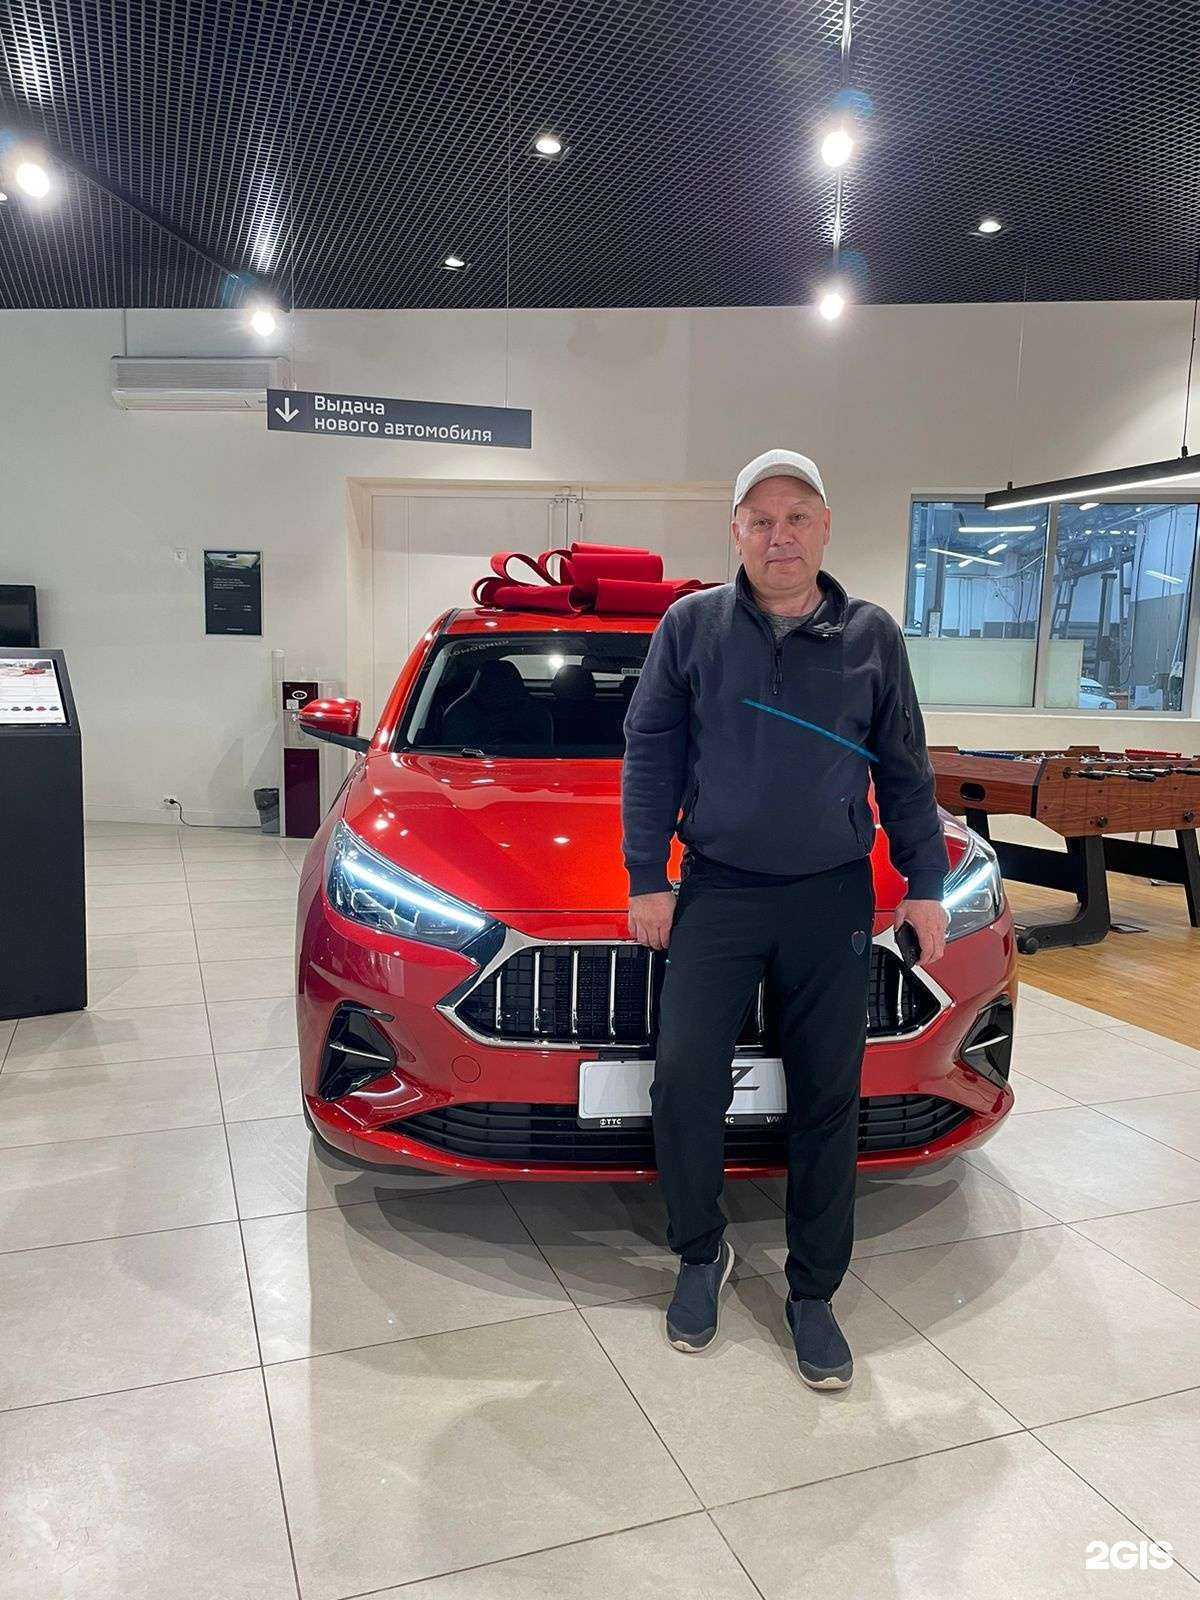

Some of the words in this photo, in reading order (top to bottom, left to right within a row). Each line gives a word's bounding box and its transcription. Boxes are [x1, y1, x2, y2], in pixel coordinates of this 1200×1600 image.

[314, 395, 385, 415] Выдача
[314, 417, 379, 434] нового
[384, 422, 492, 442] автомобиля
